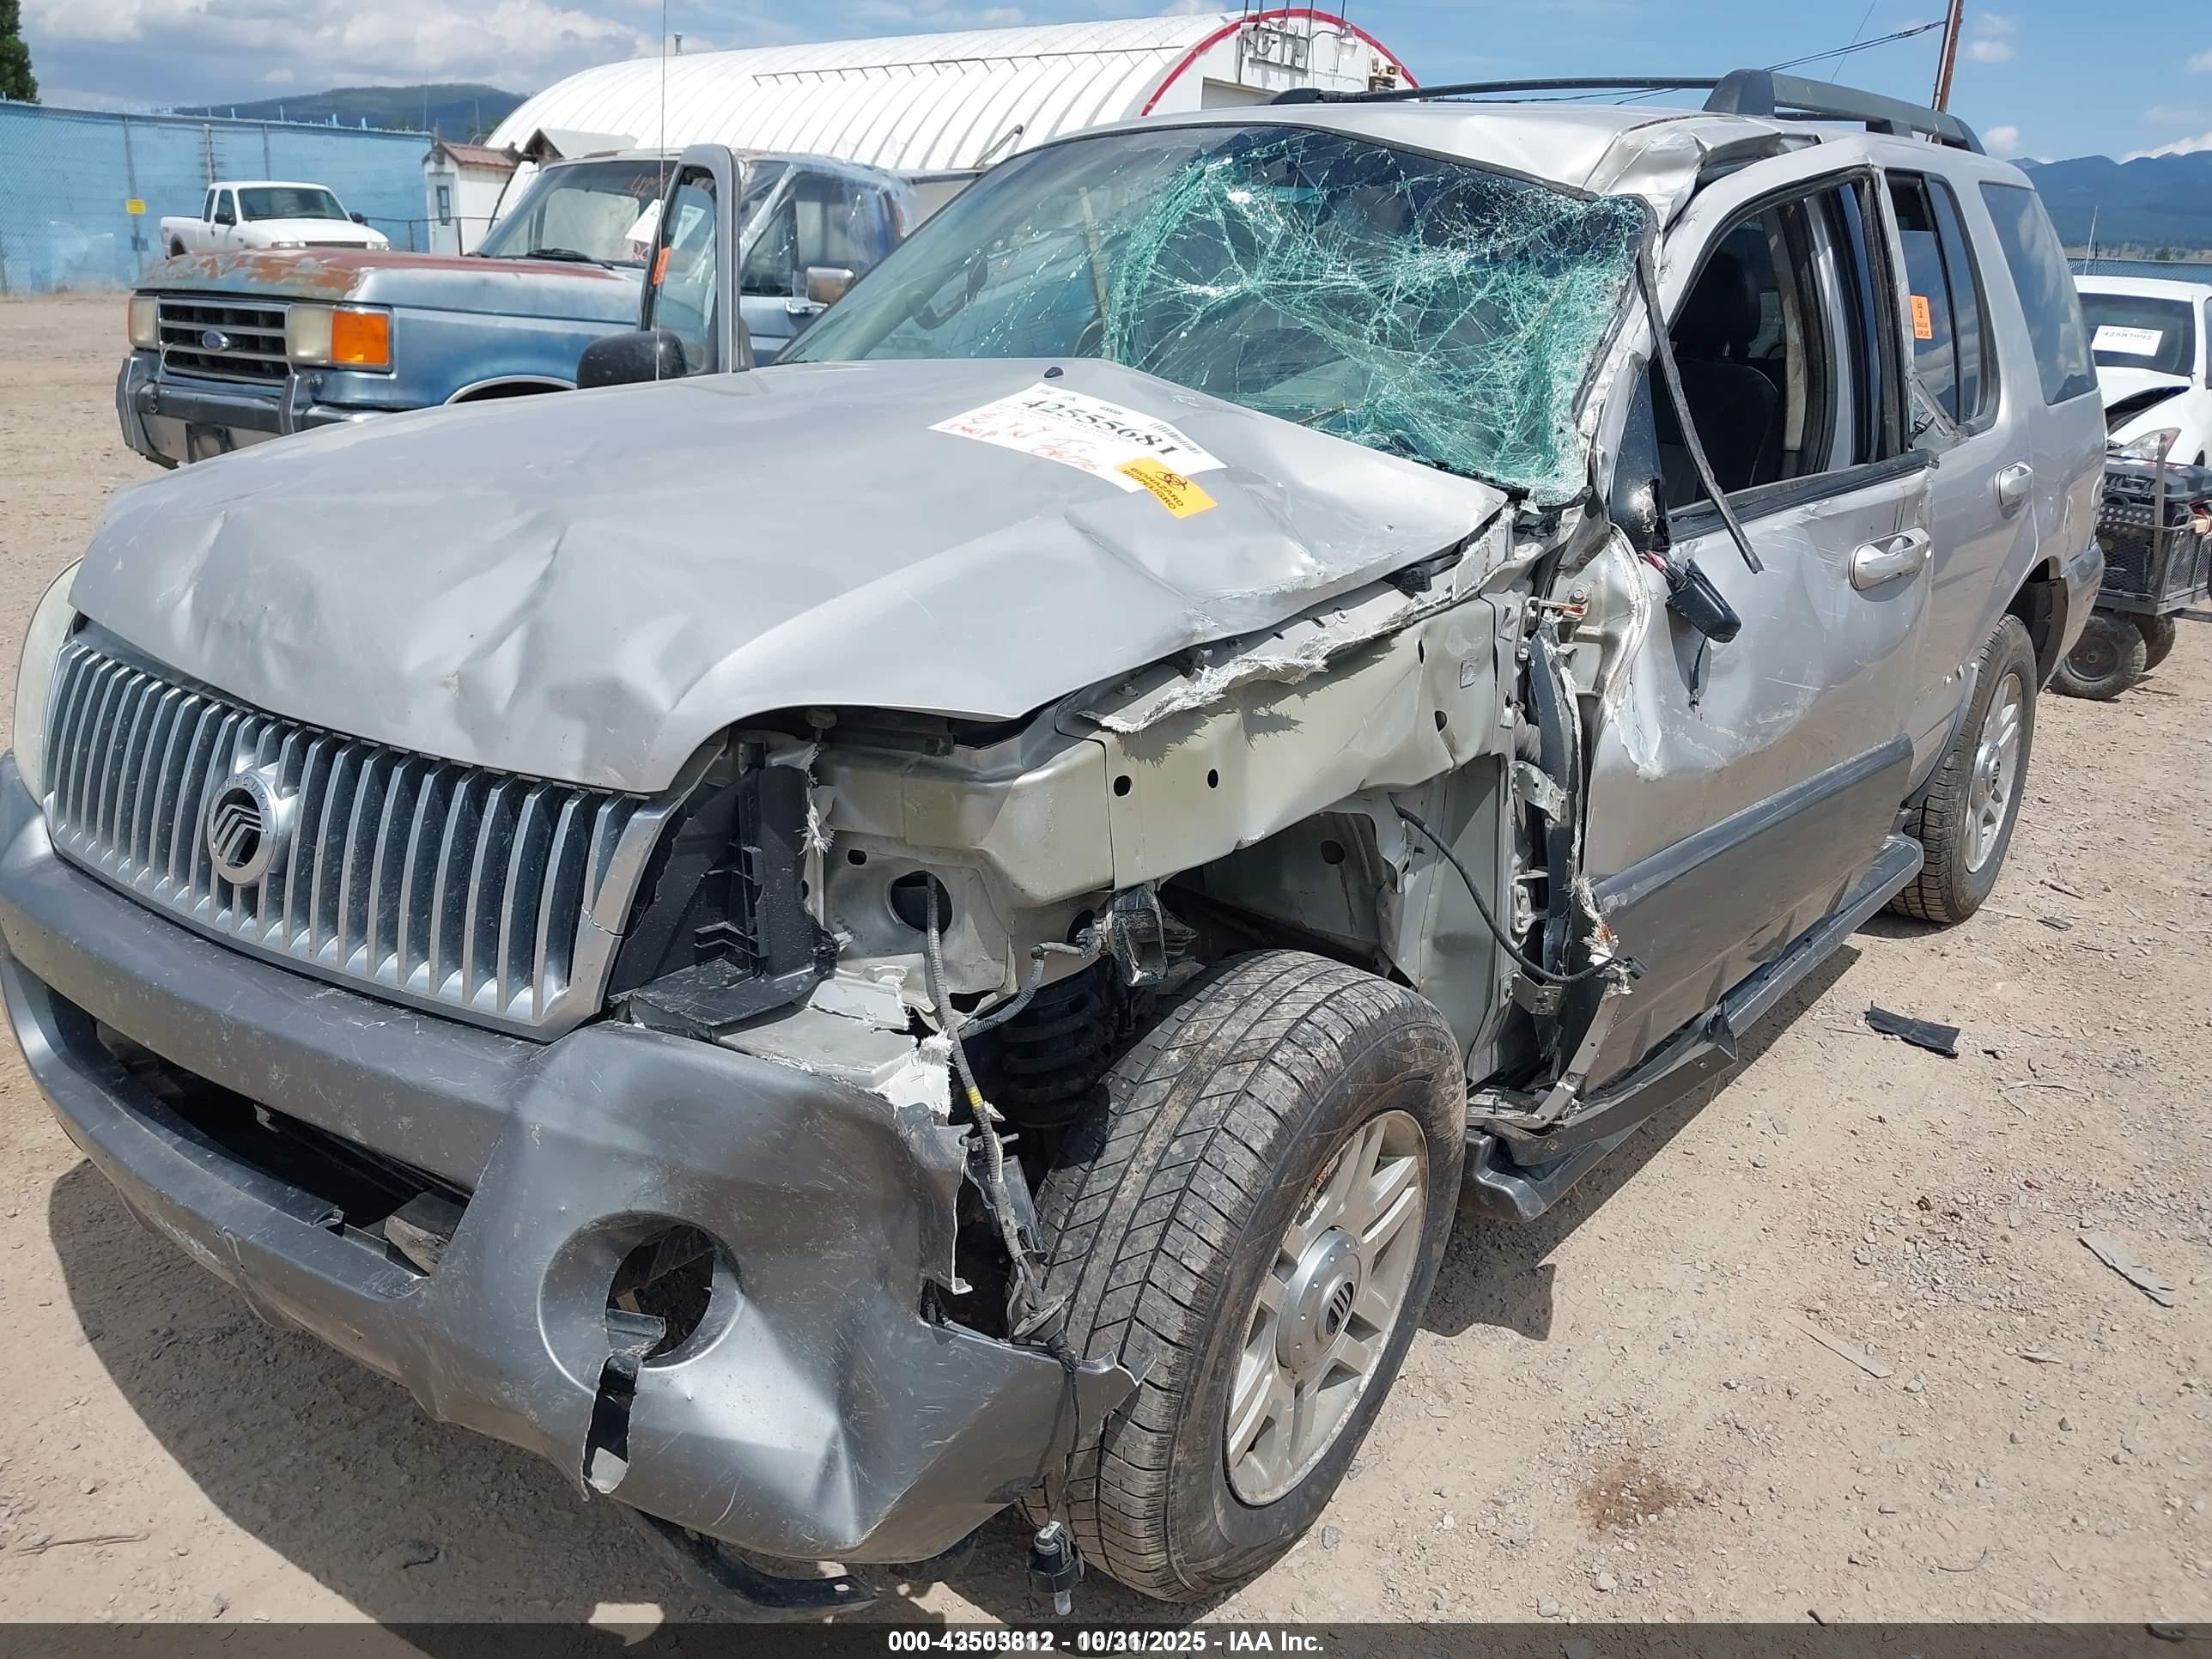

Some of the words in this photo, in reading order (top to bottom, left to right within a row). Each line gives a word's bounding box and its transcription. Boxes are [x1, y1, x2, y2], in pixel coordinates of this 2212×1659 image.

[1020, 400, 1179, 455] 42555681
[1121, 470, 1176, 510] BIOPELIGRO
[1130, 466, 1184, 507] BIOHAZARD
